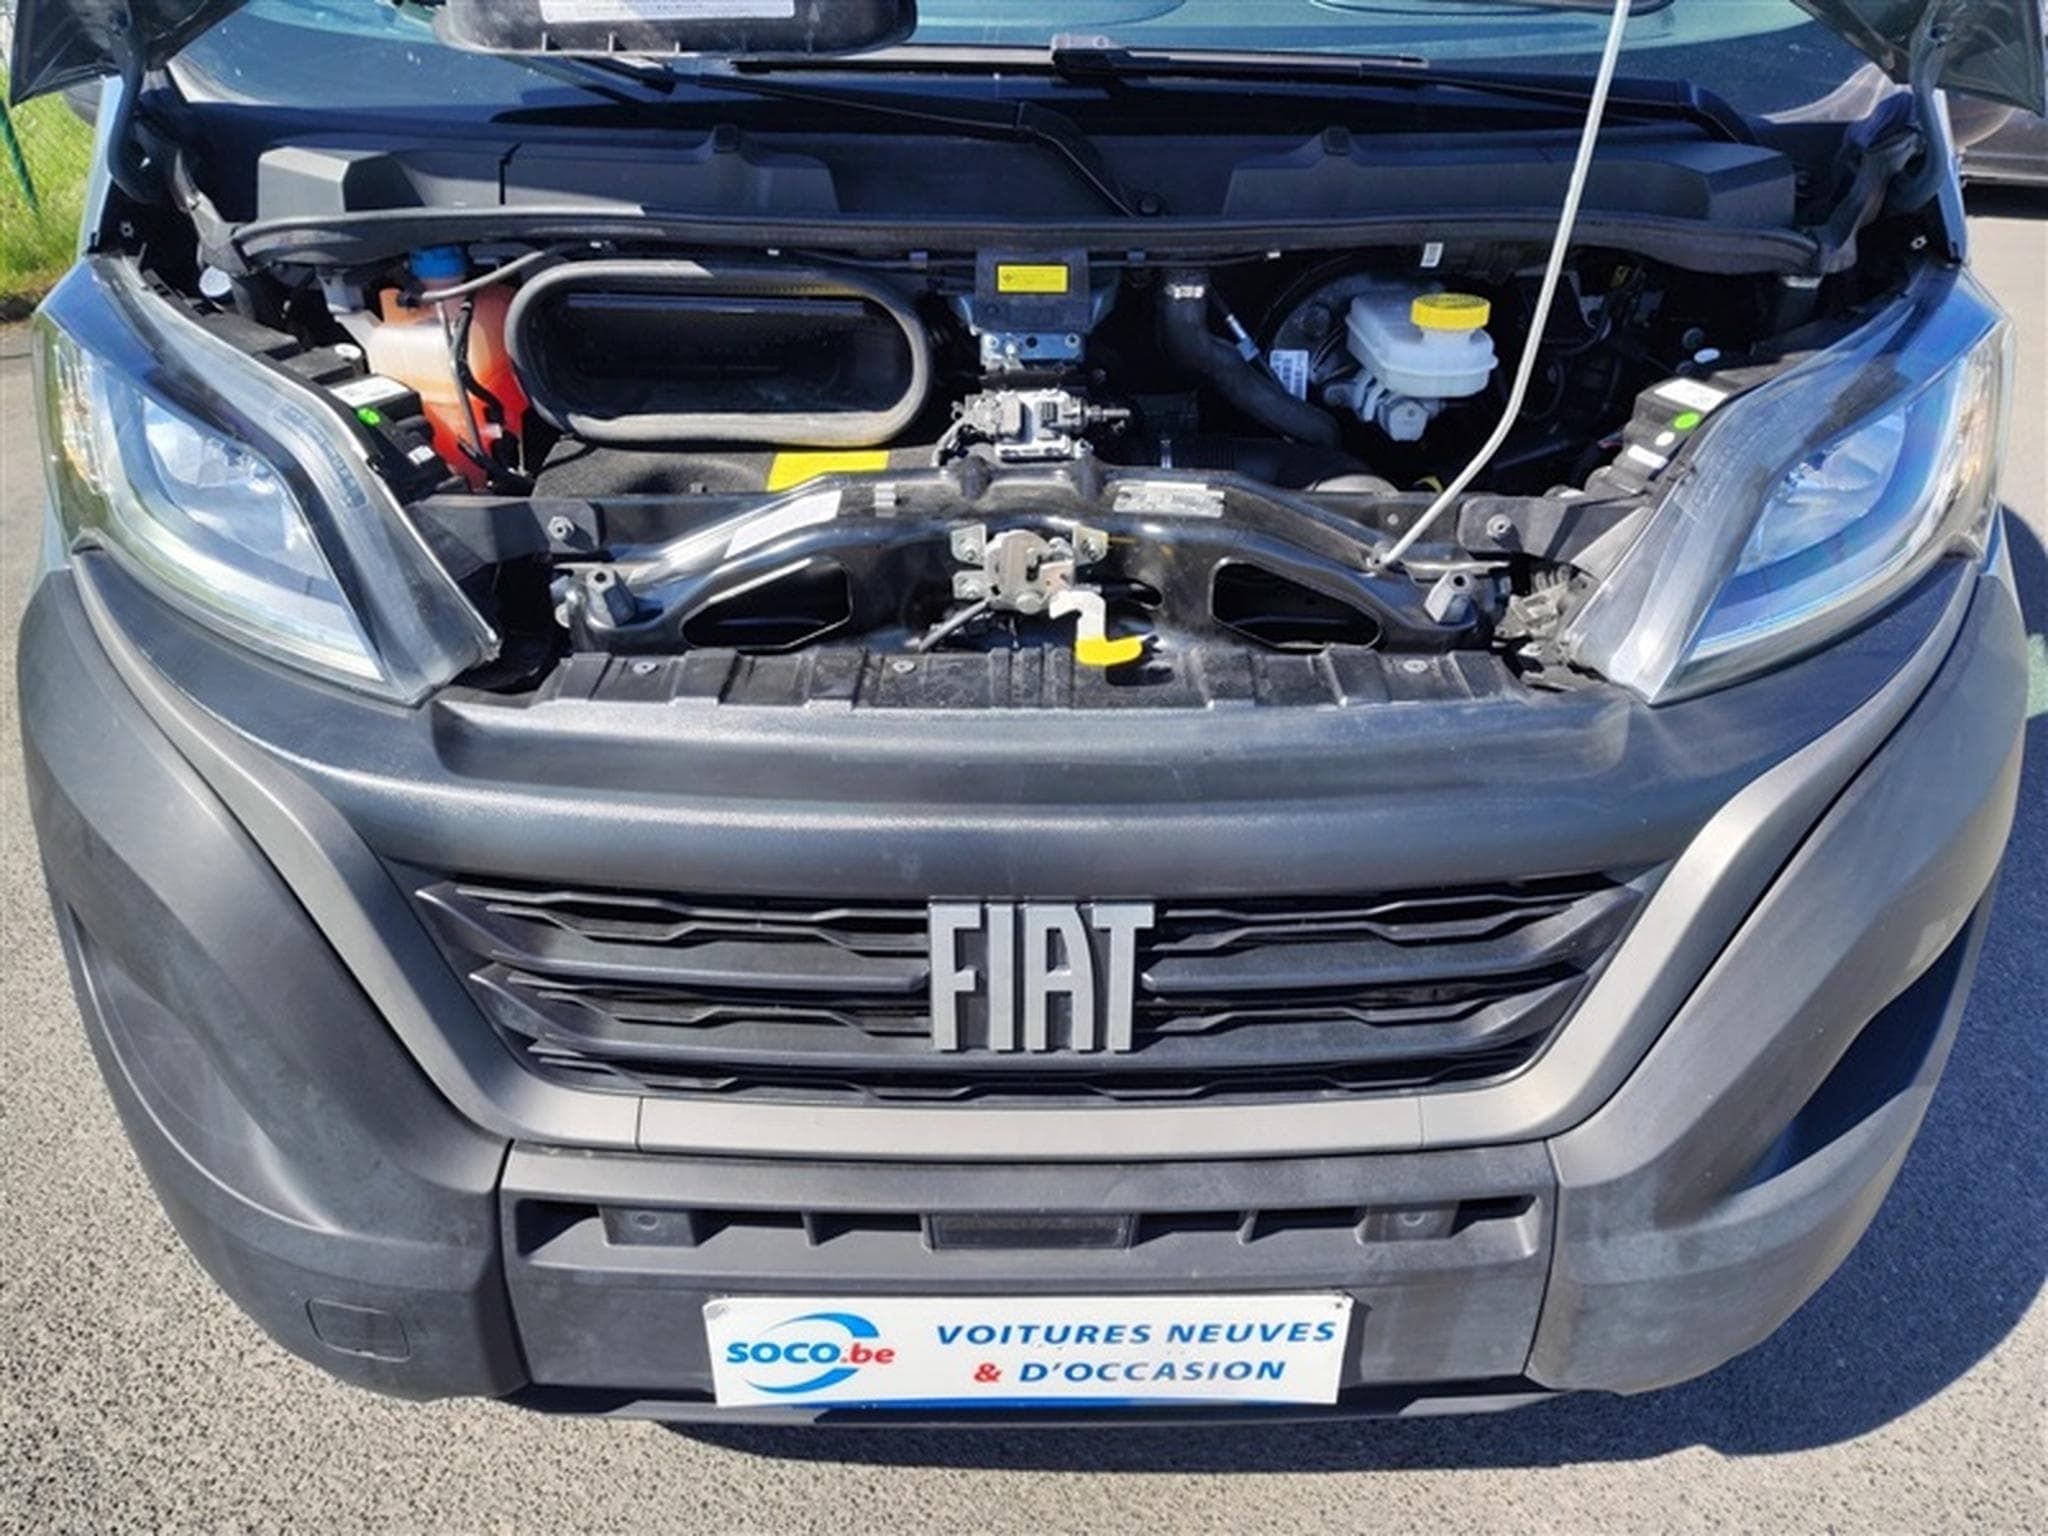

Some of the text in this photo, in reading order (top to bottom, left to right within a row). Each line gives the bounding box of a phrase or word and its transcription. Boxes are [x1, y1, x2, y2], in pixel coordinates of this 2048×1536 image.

[928, 901, 1155, 1051] FIAT
[936, 1322, 1337, 1345] VOITURES NEUVES
[726, 1341, 896, 1365] SOCO.be
[973, 1361, 1287, 1384] & D'OCCASION
